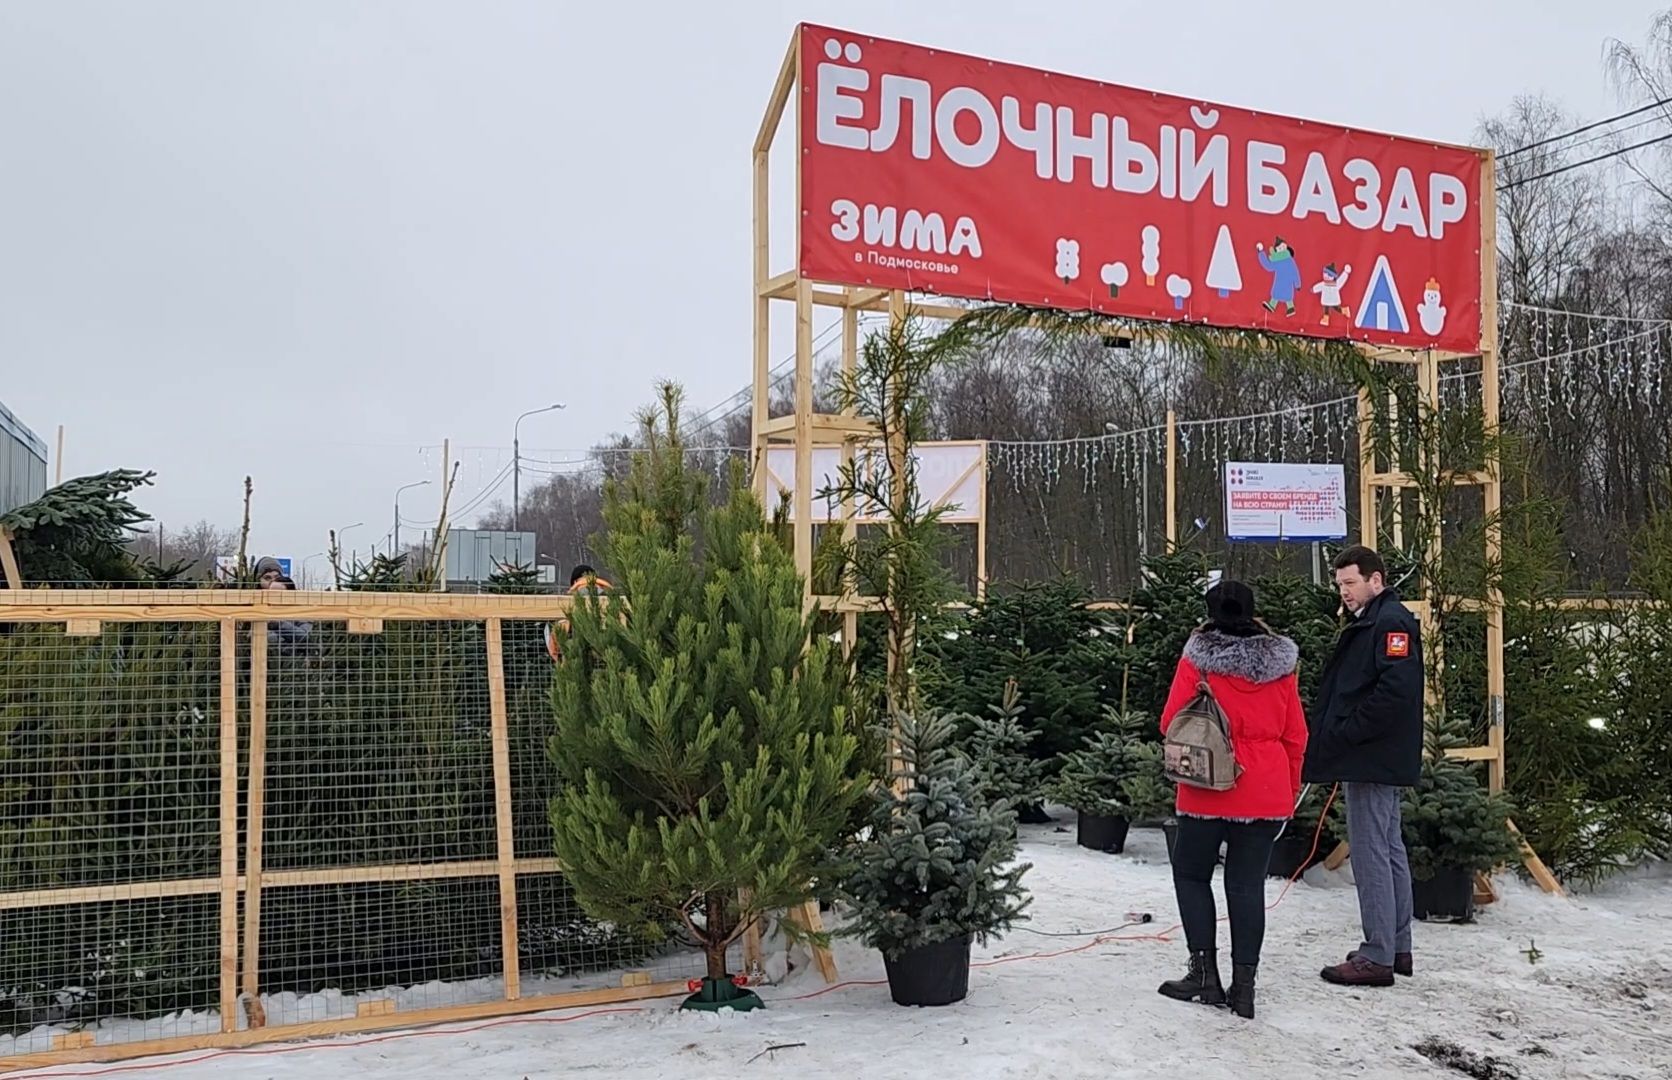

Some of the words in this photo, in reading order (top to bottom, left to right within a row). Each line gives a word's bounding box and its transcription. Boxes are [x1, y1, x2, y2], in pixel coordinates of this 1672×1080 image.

[817, 38, 1229, 207] ЁЛОЧНЫЙ
[1247, 140, 1467, 240] БАЗАР
[831, 199, 983, 258] ЗИМА
[854, 252, 863, 263] в
[867, 251, 959, 275] Подмосковье
